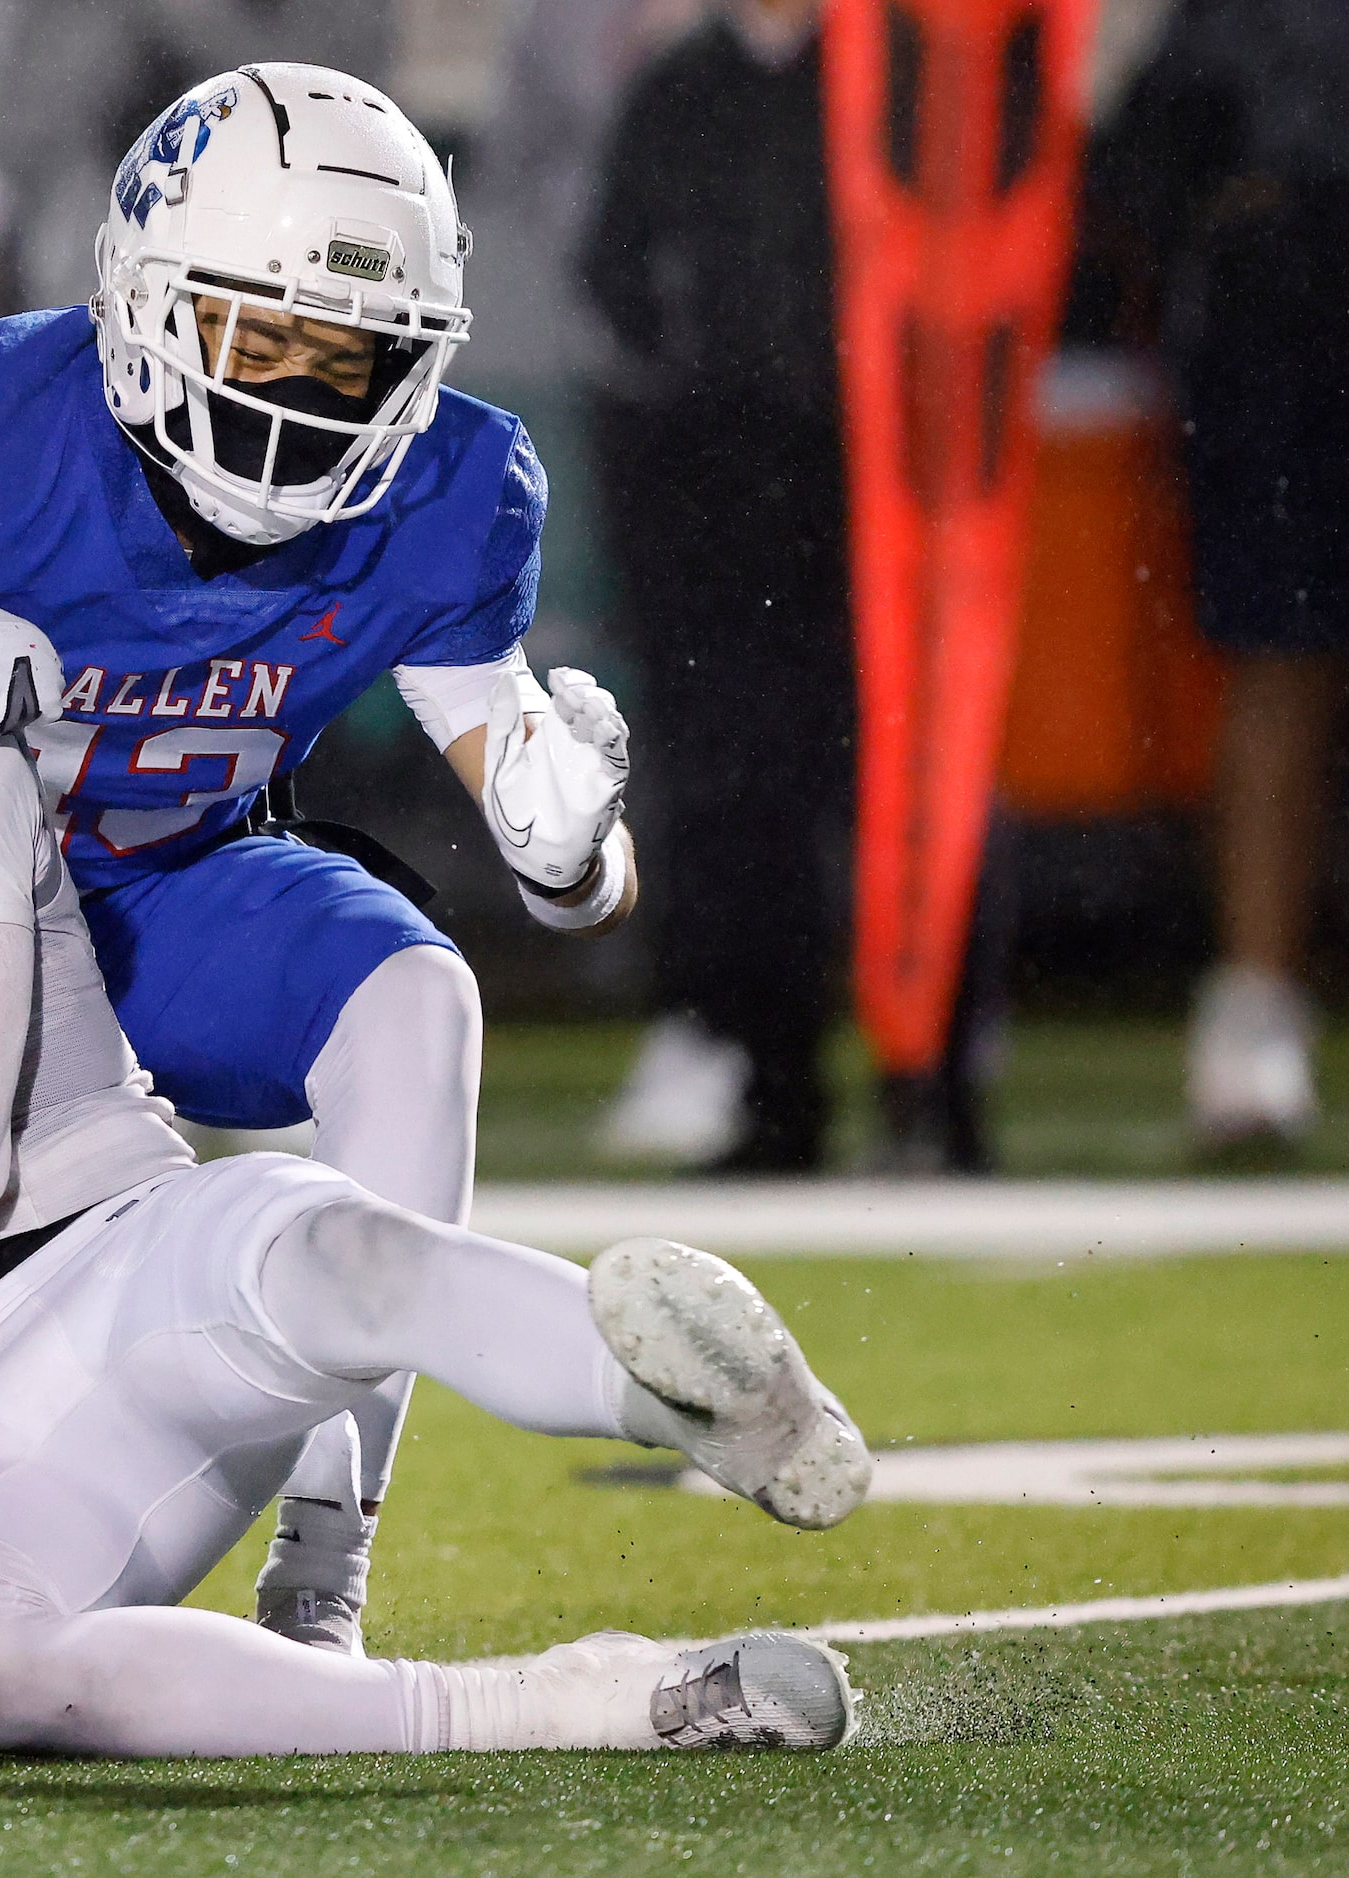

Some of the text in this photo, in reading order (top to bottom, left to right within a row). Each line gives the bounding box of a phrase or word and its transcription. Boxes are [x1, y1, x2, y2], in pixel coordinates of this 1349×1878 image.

[331, 250, 387, 273] schutt
[60, 658, 296, 719] ALLEN
[24, 719, 291, 857] 13
